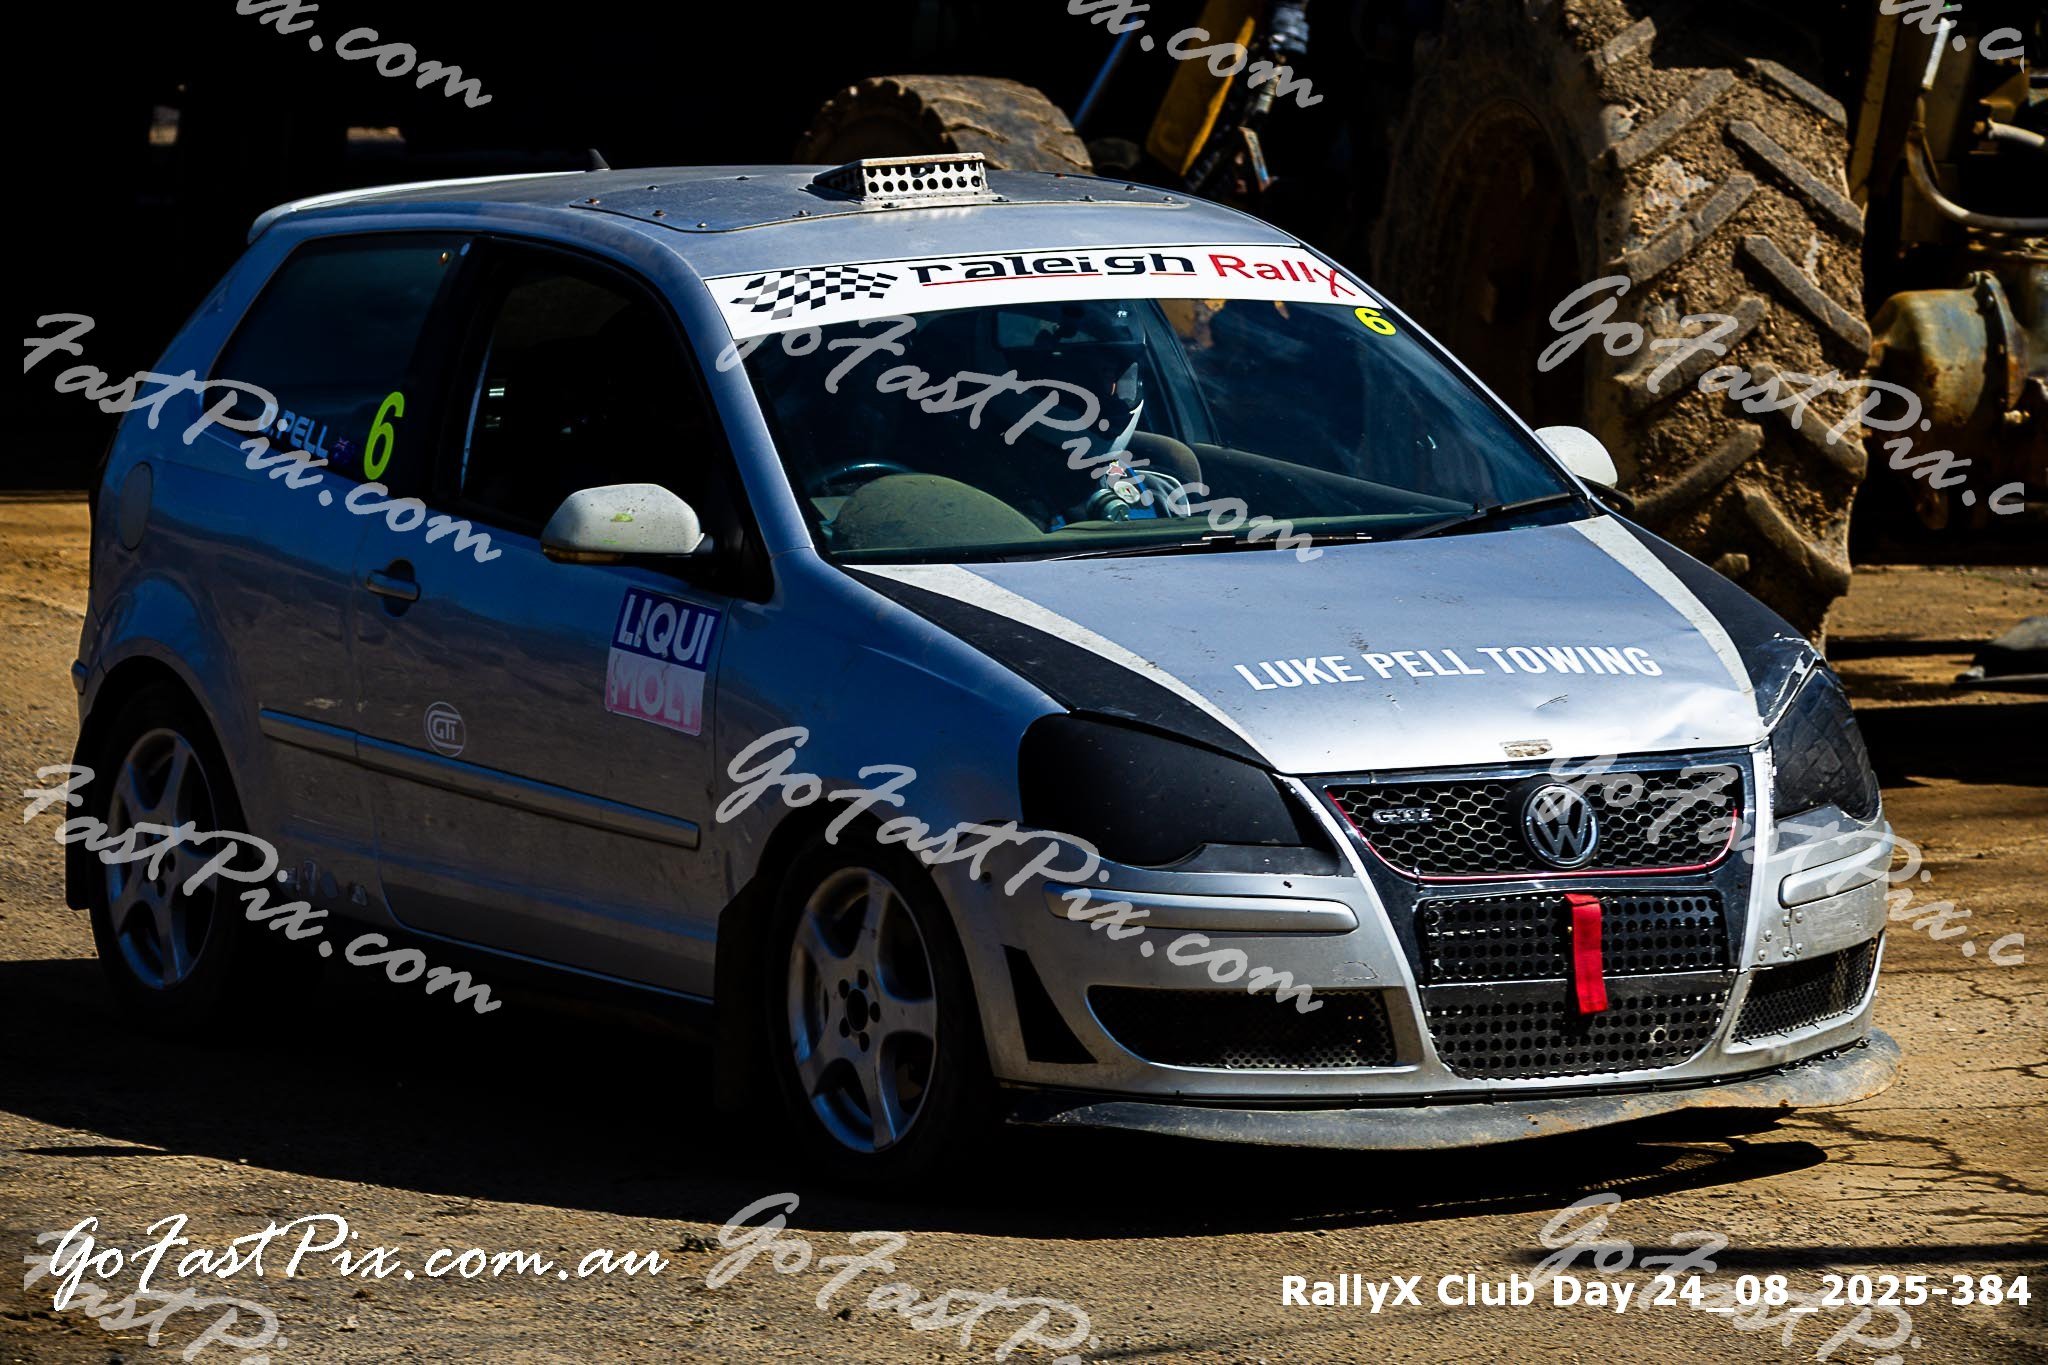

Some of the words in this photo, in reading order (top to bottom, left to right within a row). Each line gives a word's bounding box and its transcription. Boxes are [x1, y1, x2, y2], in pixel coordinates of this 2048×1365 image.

[907, 252, 1196, 285] raleigh
[1354, 307, 1397, 336] 6
[363, 391, 405, 480] 6
[617, 594, 716, 665] LIQUI
[1233, 655, 1365, 690] LUKE
[1362, 648, 1486, 679] PELL
[1476, 646, 1664, 677] TOWING
